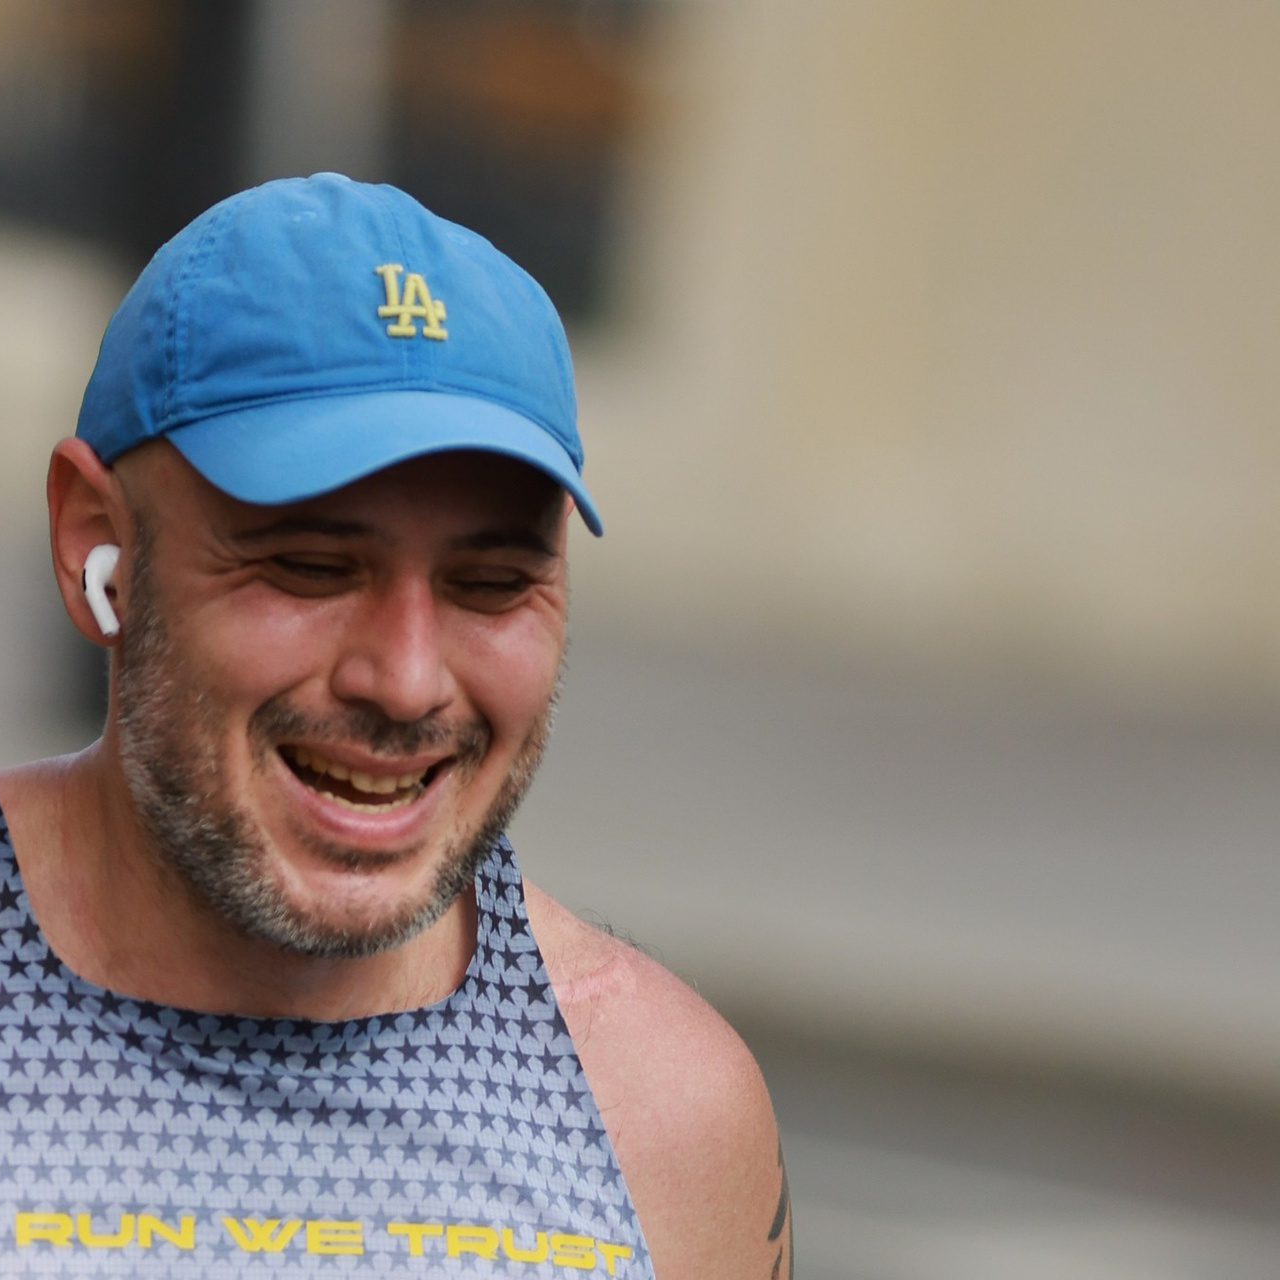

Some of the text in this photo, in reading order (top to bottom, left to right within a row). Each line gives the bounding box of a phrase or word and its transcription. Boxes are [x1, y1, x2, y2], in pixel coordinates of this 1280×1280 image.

[375, 264, 448, 340] LA
[15, 1213, 195, 1250] RUN
[221, 1217, 364, 1256] WE
[386, 1222, 633, 1277] TRUST
